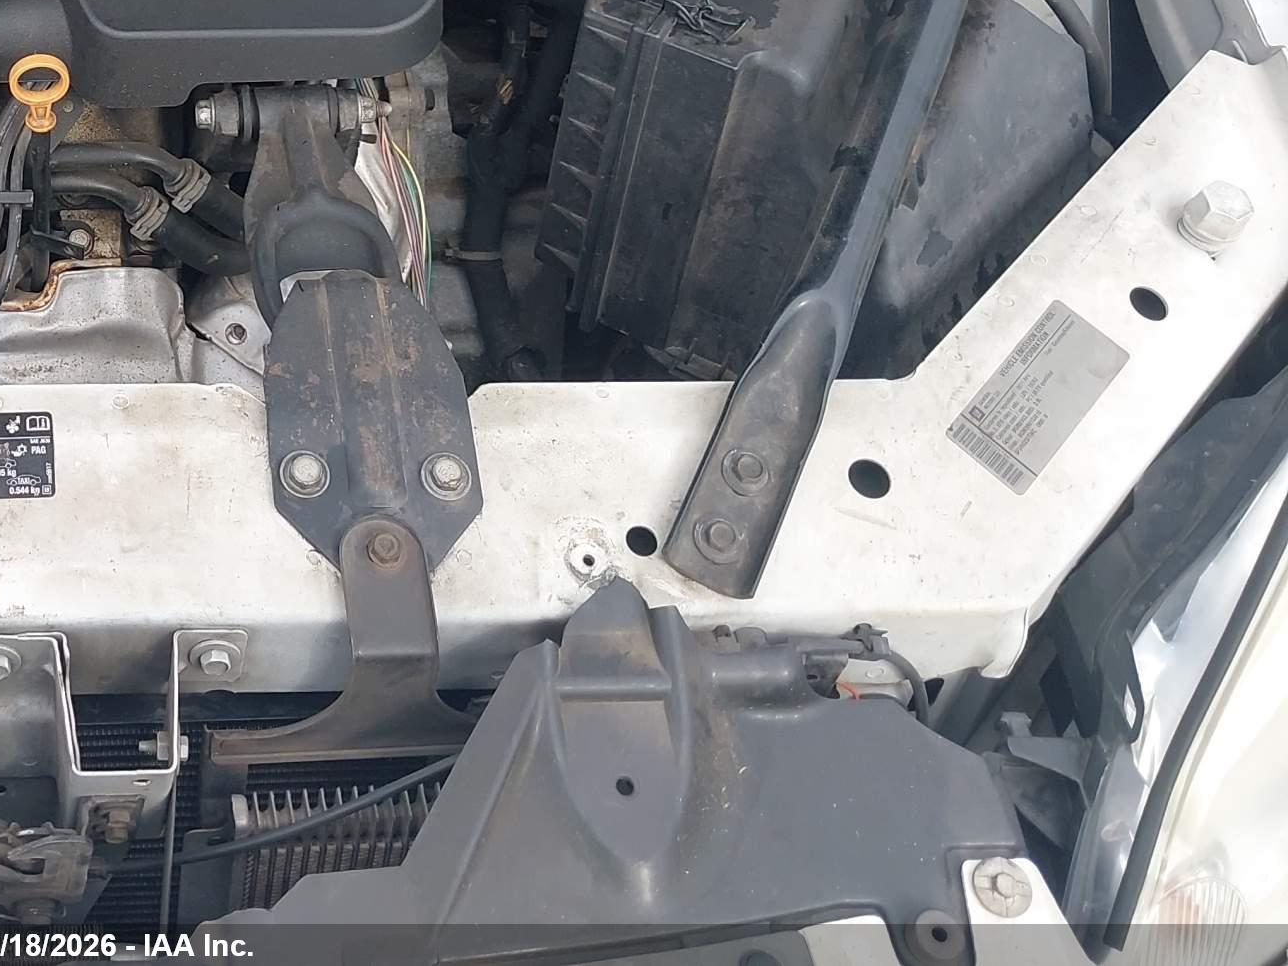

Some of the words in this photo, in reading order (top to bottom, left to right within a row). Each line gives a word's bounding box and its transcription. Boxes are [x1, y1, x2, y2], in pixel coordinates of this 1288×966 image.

[998, 354, 1019, 377] VEHICLE
[1014, 331, 1037, 357] EMISSION
[1033, 310, 1055, 334] CONTROL
[1019, 330, 1049, 365] INFORMATION
[31, 445, 47, 454] PAG
[7, 469, 17, 478] kg
[9, 486, 29, 495] 0.544
[30, 486, 41, 496] kg
